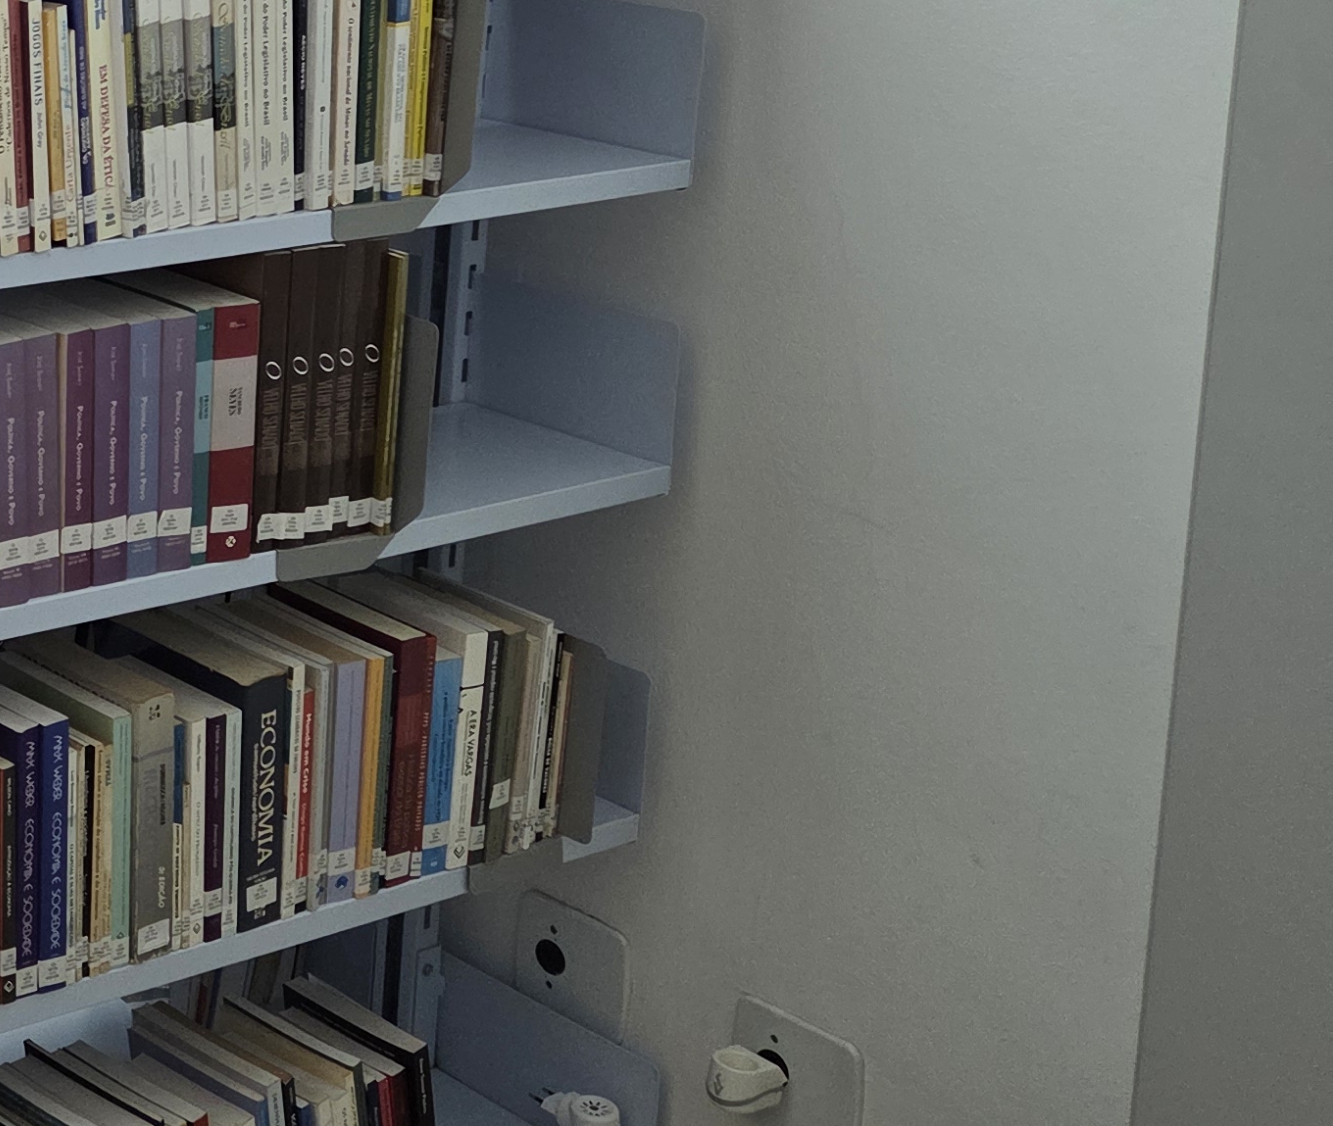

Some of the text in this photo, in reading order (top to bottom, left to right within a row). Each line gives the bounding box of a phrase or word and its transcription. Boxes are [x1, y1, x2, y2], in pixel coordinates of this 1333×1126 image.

[262, 15, 270, 38] Poder
[31, 18, 43, 107] JOGOS FINAIS
[261, 39, 270, 87] Legislativo
[26, 741, 36, 767] MAX
[52, 734, 63, 763] MAX
[301, 712, 313, 794] Mundo em Crise
[464, 709, 478, 778] A ERA VARGAS
[25, 770, 36, 809] WEBER
[52, 765, 63, 802] WEBER
[257, 709, 277, 867] ECONOMIA
[24, 818, 35, 881] ECONOMIA
[51, 812, 63, 876] ECONOMIA
[21, 895, 34, 958] SOCIEDADE
[50, 887, 62, 950] SOCIEDADE
